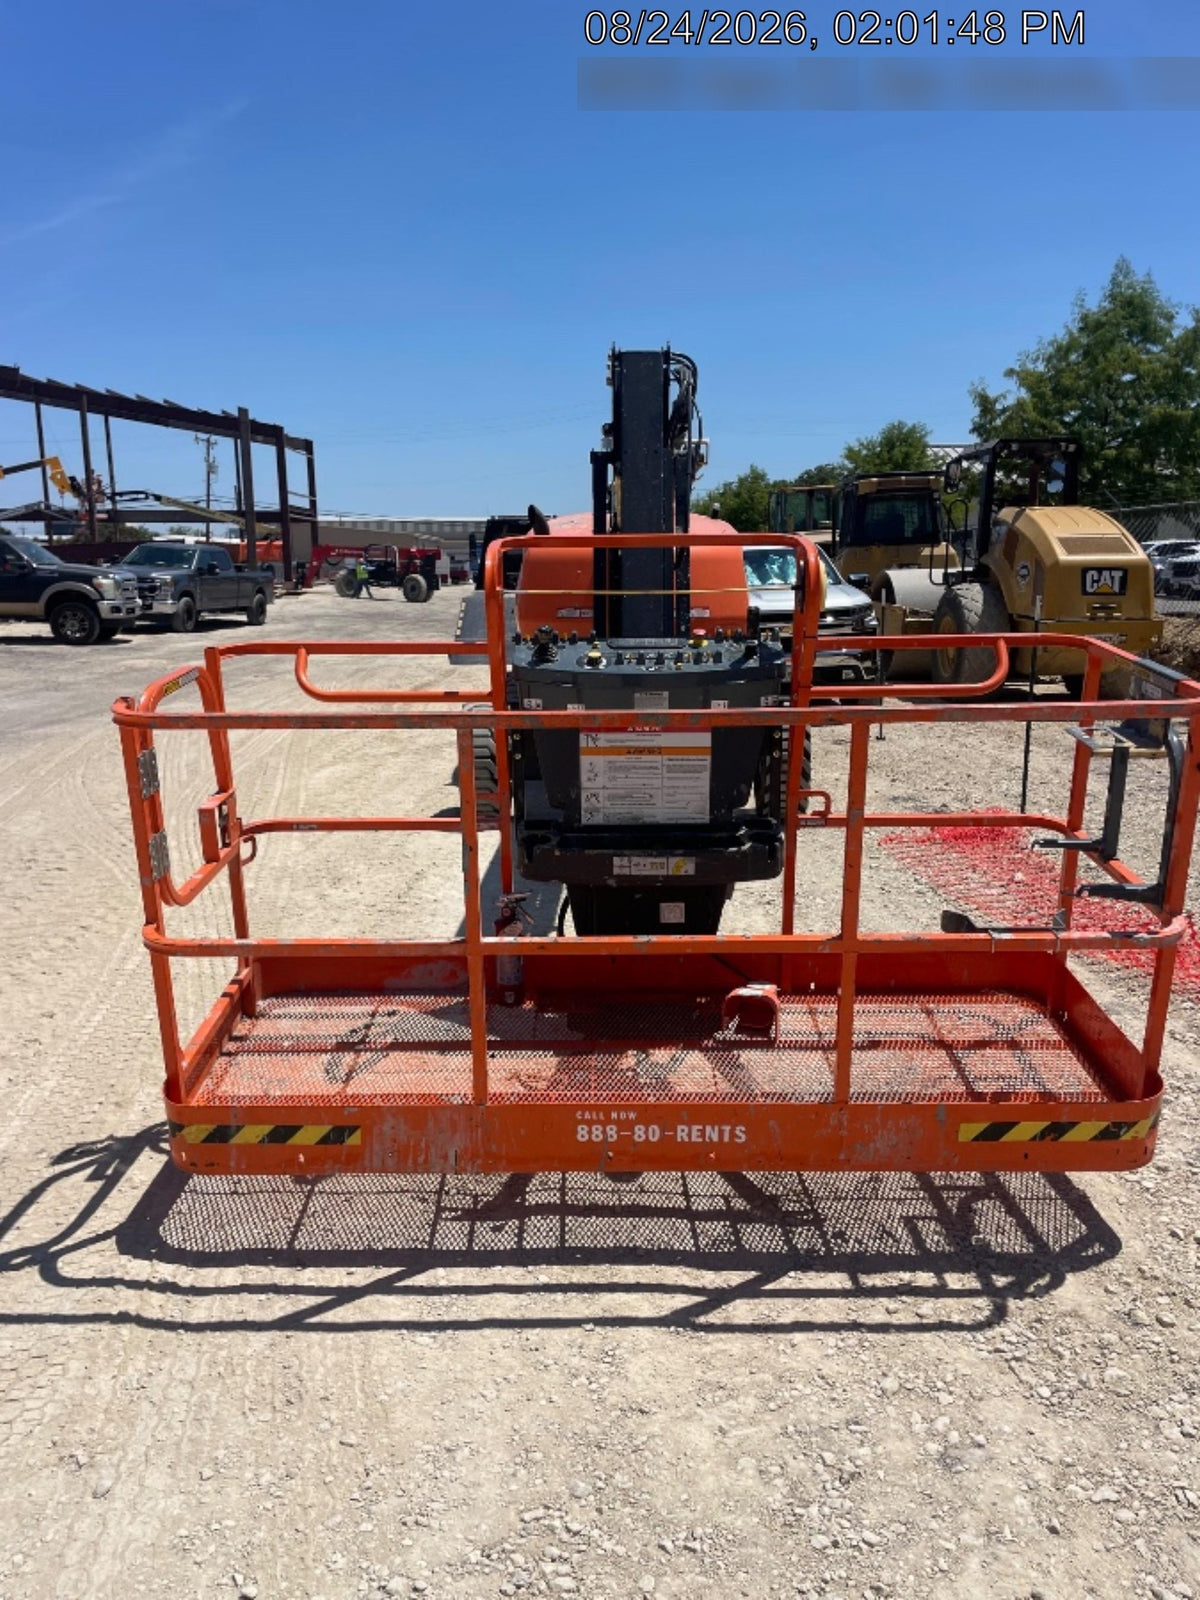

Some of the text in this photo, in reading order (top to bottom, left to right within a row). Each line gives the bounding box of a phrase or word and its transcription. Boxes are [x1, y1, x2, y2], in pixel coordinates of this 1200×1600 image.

[1085, 569, 1124, 593] CAT
[575, 1110, 637, 1121] CALL NOW
[576, 1124, 747, 1143] 888-80-RENTS
